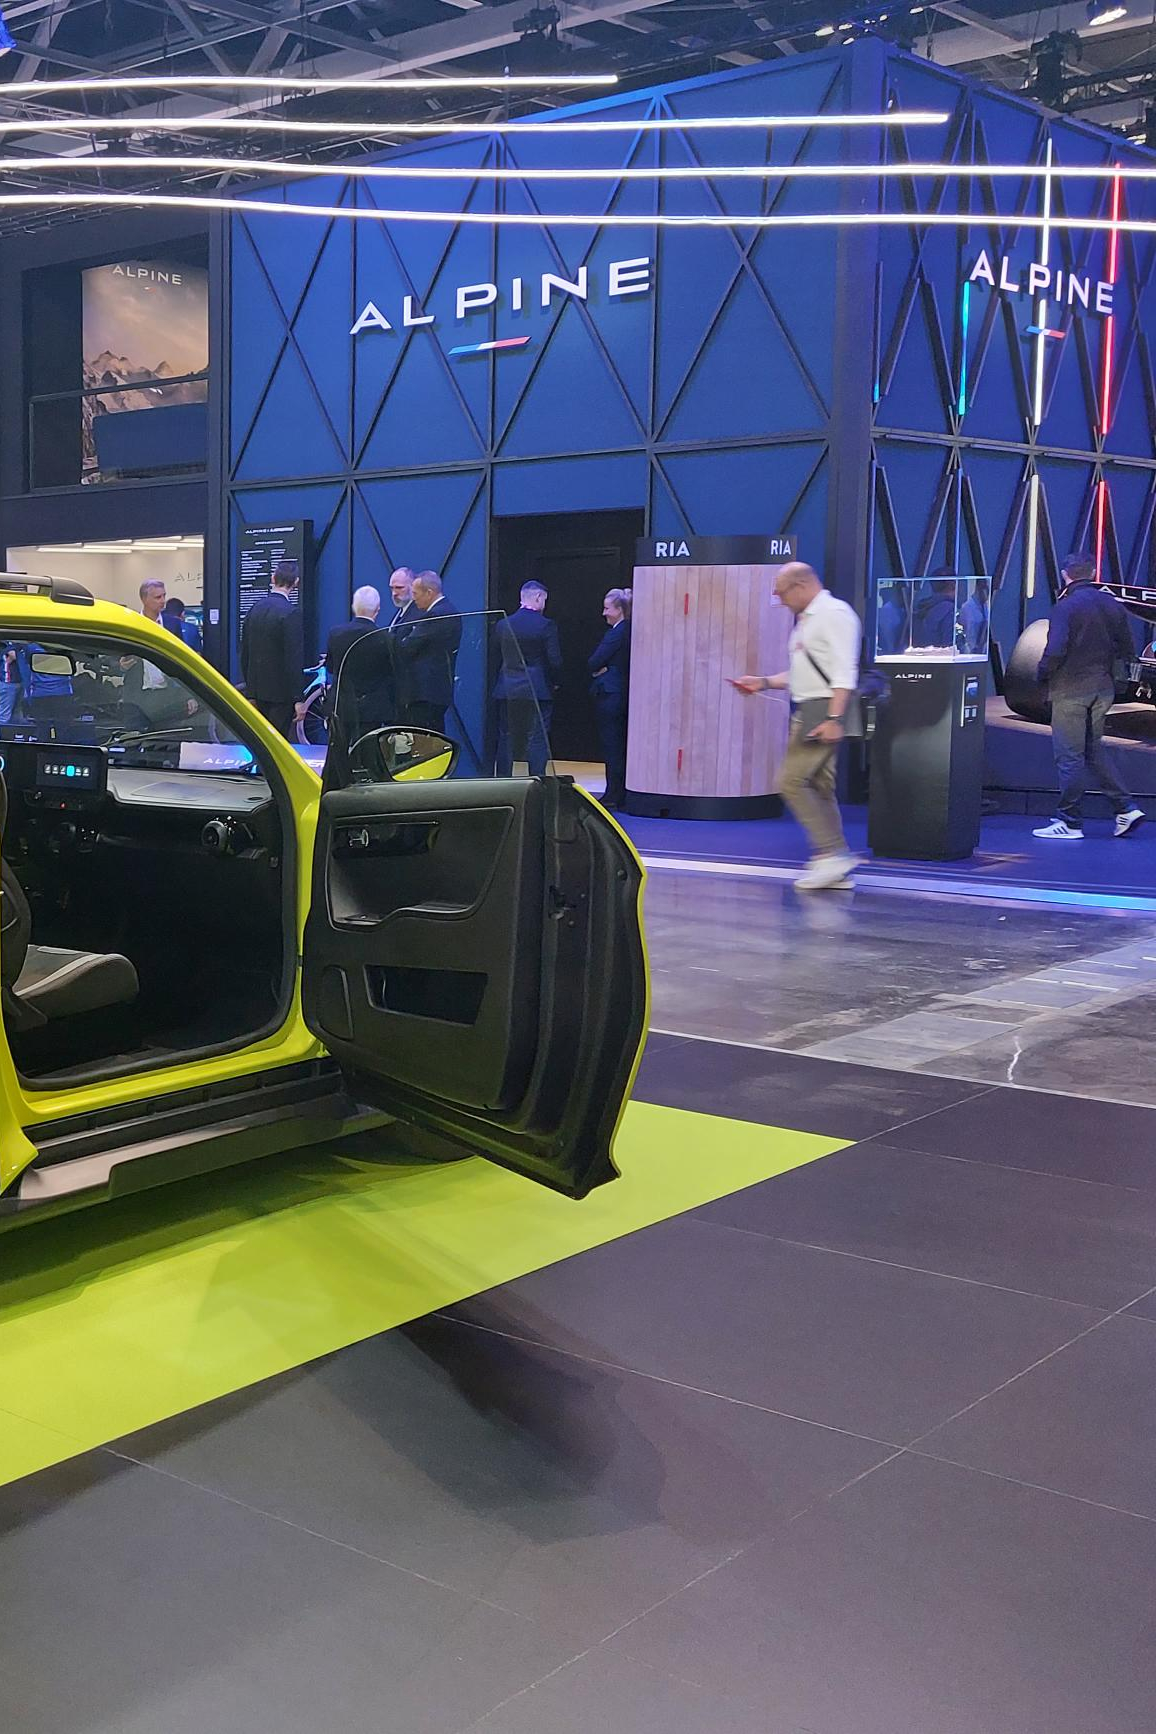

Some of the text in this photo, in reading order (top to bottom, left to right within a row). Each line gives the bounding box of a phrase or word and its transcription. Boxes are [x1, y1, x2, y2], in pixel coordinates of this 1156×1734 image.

[112, 265, 182, 285] ALPINE
[969, 249, 1114, 314] ALPINE
[349, 257, 650, 335] ALPINE
[655, 541, 690, 558] RIA
[770, 540, 792, 556] RIA
